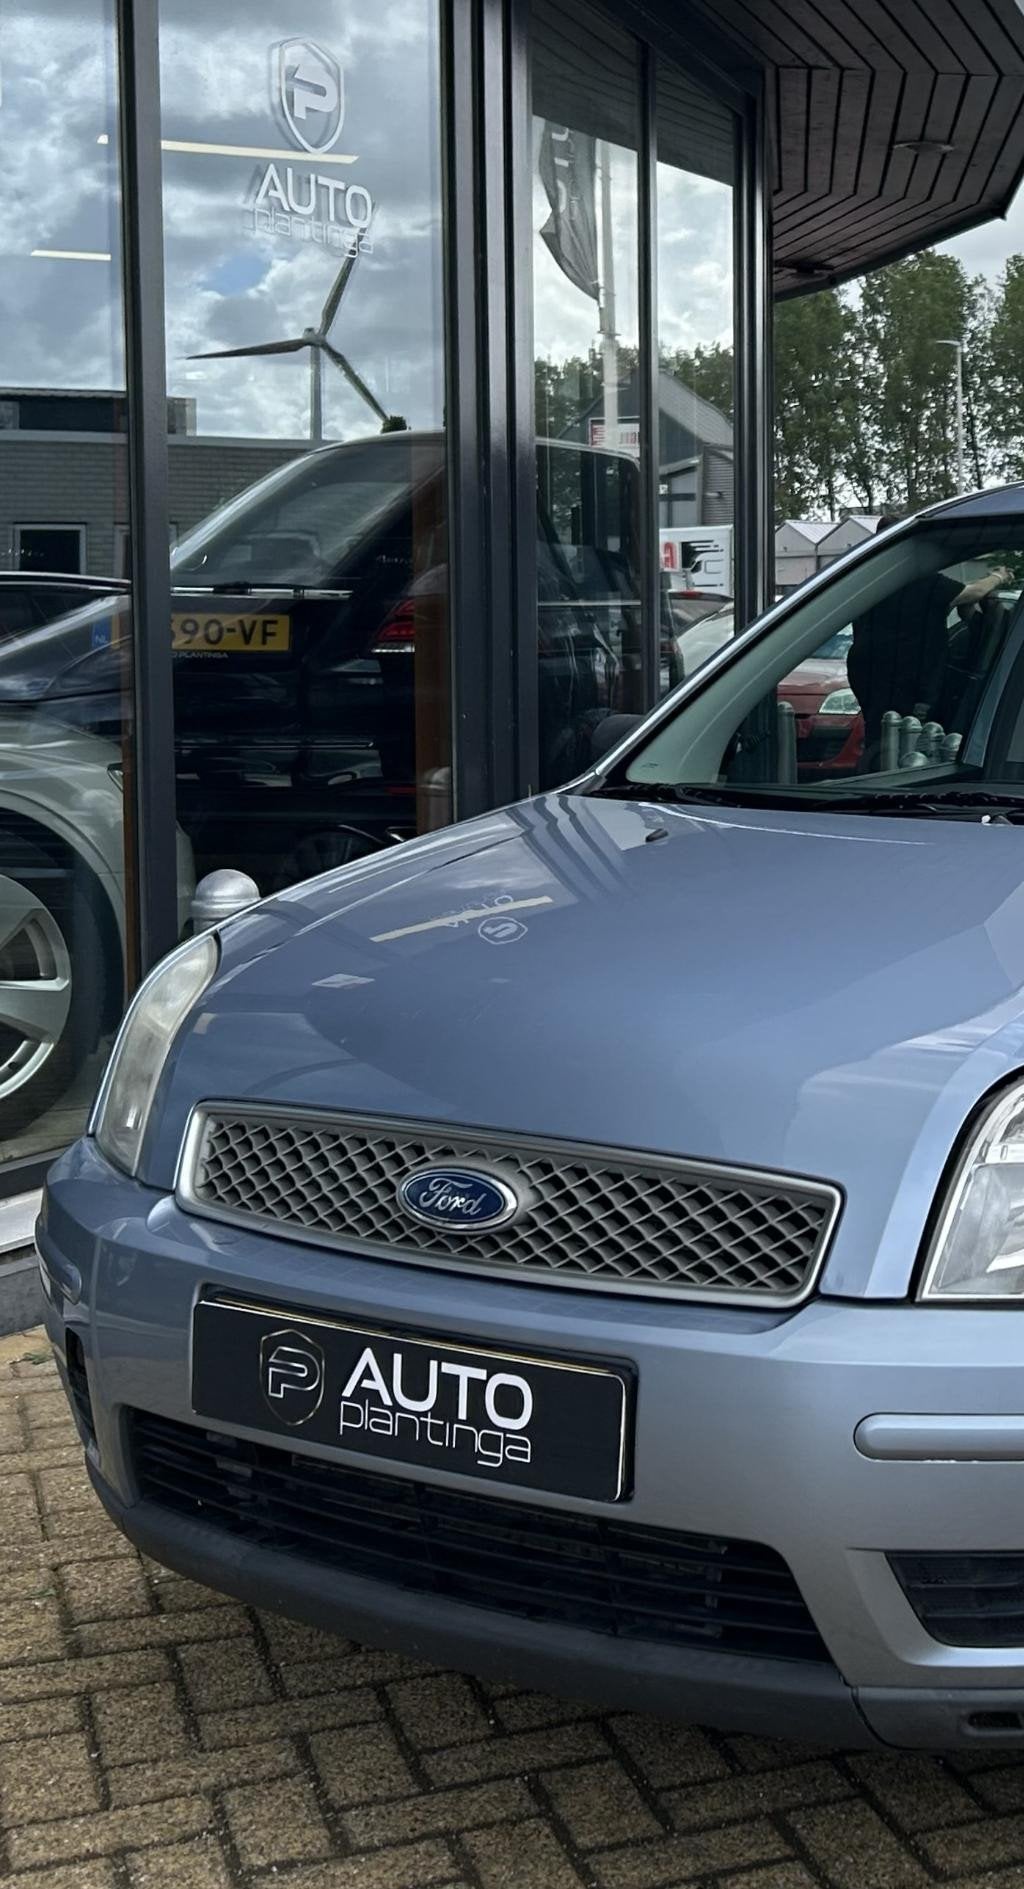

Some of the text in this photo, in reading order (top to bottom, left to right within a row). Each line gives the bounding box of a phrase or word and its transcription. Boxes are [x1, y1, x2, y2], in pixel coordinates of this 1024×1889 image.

[255, 163, 372, 228] AUTO
[254, 207, 374, 258] plantinga
[419, 1177, 487, 1216] Ford
[341, 1347, 534, 1431] AUTO
[339, 1400, 533, 1468] plantinga
